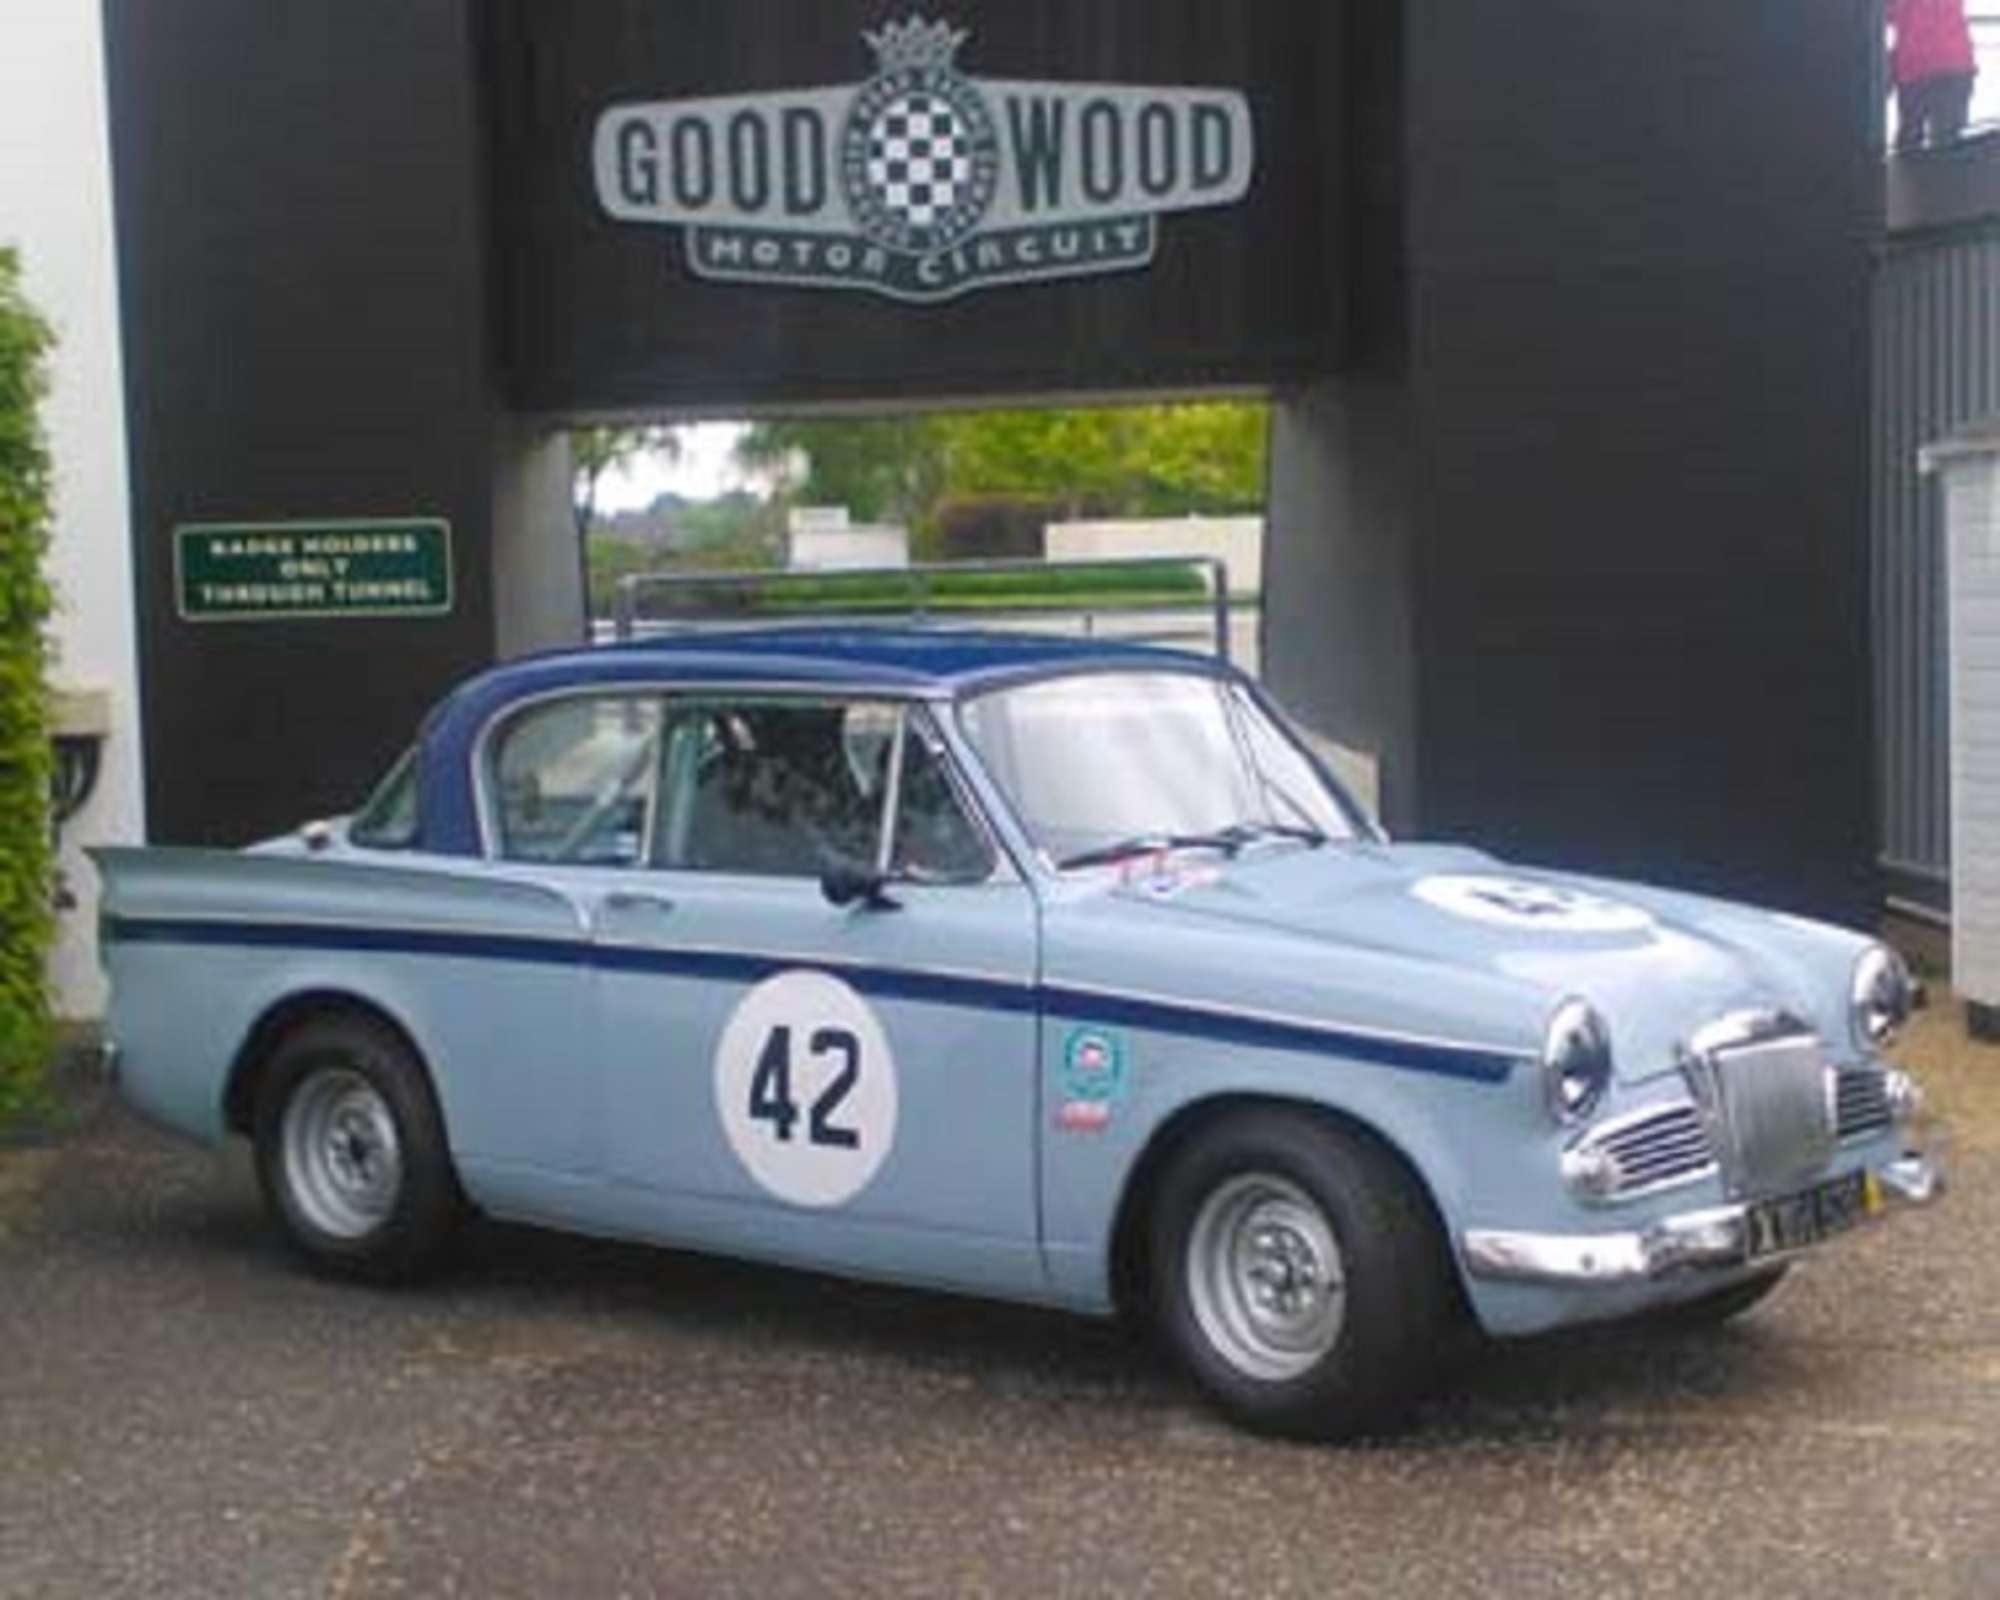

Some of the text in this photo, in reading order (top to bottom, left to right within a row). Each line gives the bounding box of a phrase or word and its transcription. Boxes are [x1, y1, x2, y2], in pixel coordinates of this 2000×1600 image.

[616, 107, 829, 214] GOOD
[1005, 97, 1232, 210] WOOD
[711, 224, 1141, 283] MOTOR CIRCUIT
[203, 578, 429, 604] THROUGH TUNNEL
[280, 557, 350, 579] ONLY
[749, 1025, 861, 1150] 42
